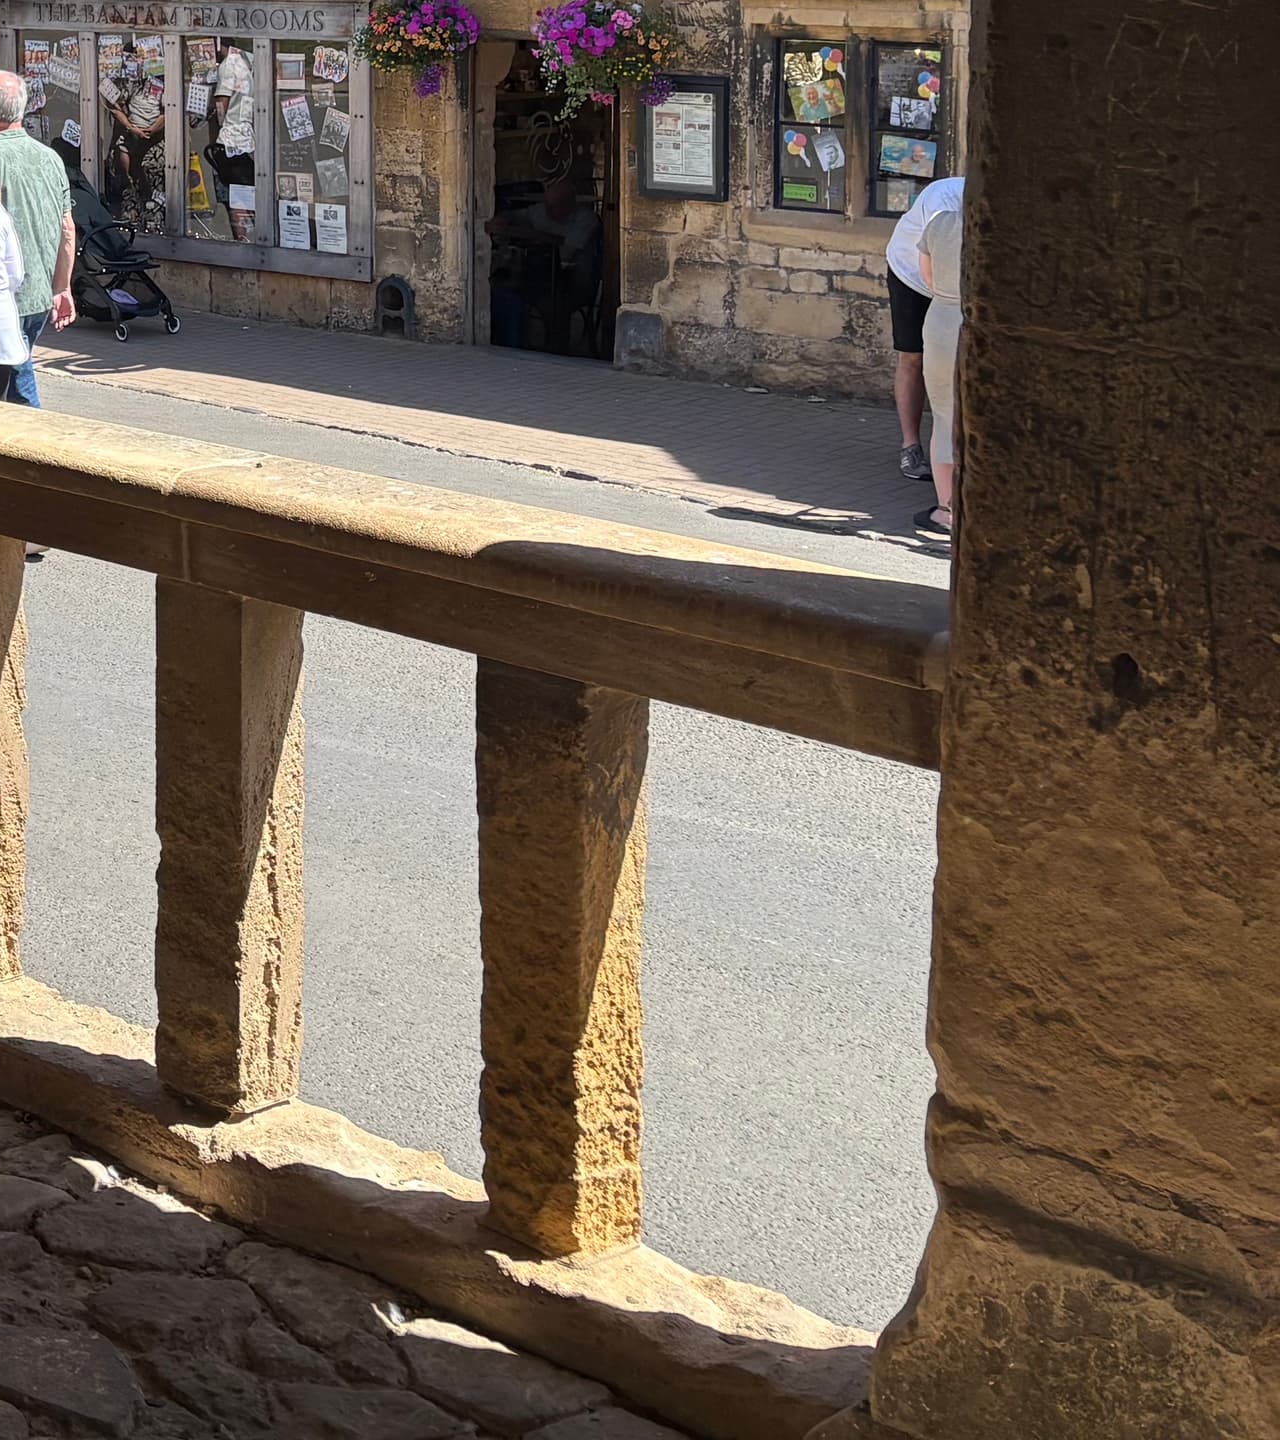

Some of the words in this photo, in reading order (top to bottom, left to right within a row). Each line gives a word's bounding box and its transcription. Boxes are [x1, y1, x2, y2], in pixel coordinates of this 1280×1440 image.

[33, 1, 81, 23] THE
[83, 2, 177, 28] BANTAM
[184, 6, 228, 28] TEA
[234, 8, 325, 32] ROOMS
